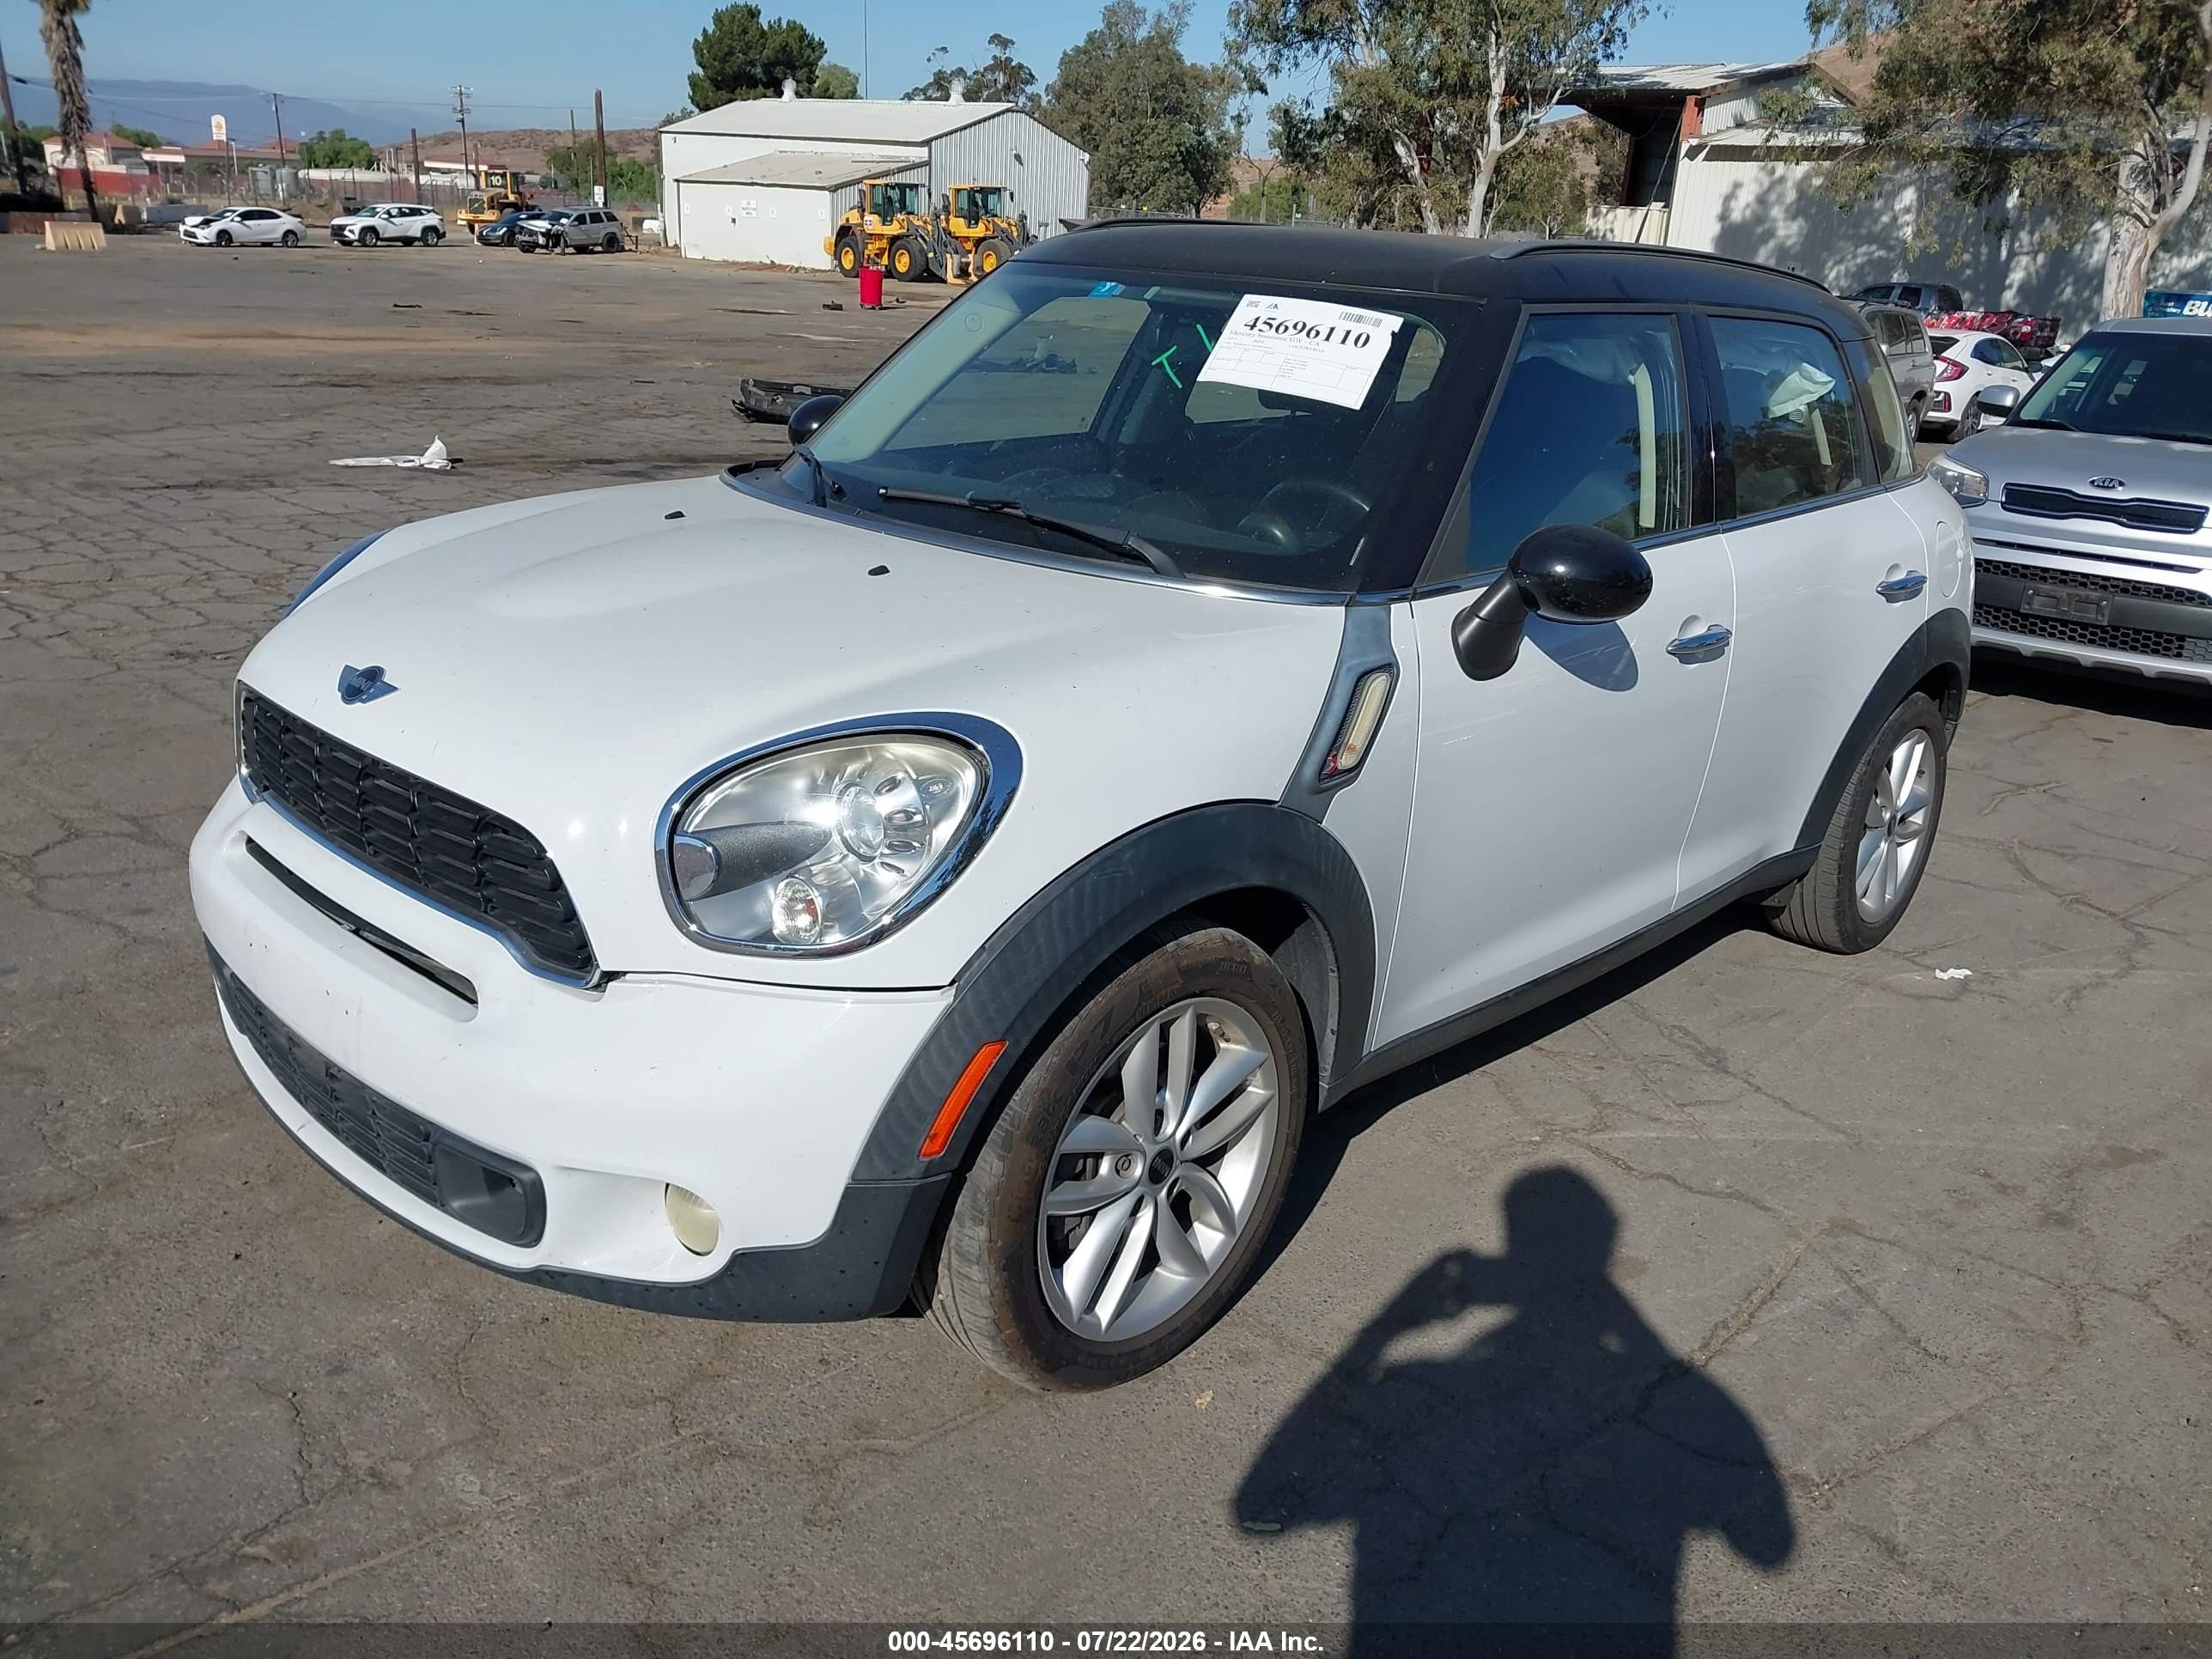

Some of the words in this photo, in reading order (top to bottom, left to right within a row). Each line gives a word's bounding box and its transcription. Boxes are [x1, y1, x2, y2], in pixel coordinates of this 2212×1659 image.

[489, 175, 502, 186] 10
[2182, 299, 2212, 317] BU
[1229, 329, 1255, 338] Mercury
[1256, 332, 1287, 343] Insurance
[1243, 314, 1371, 349] 45696110
[2094, 477, 2119, 489] KIA
